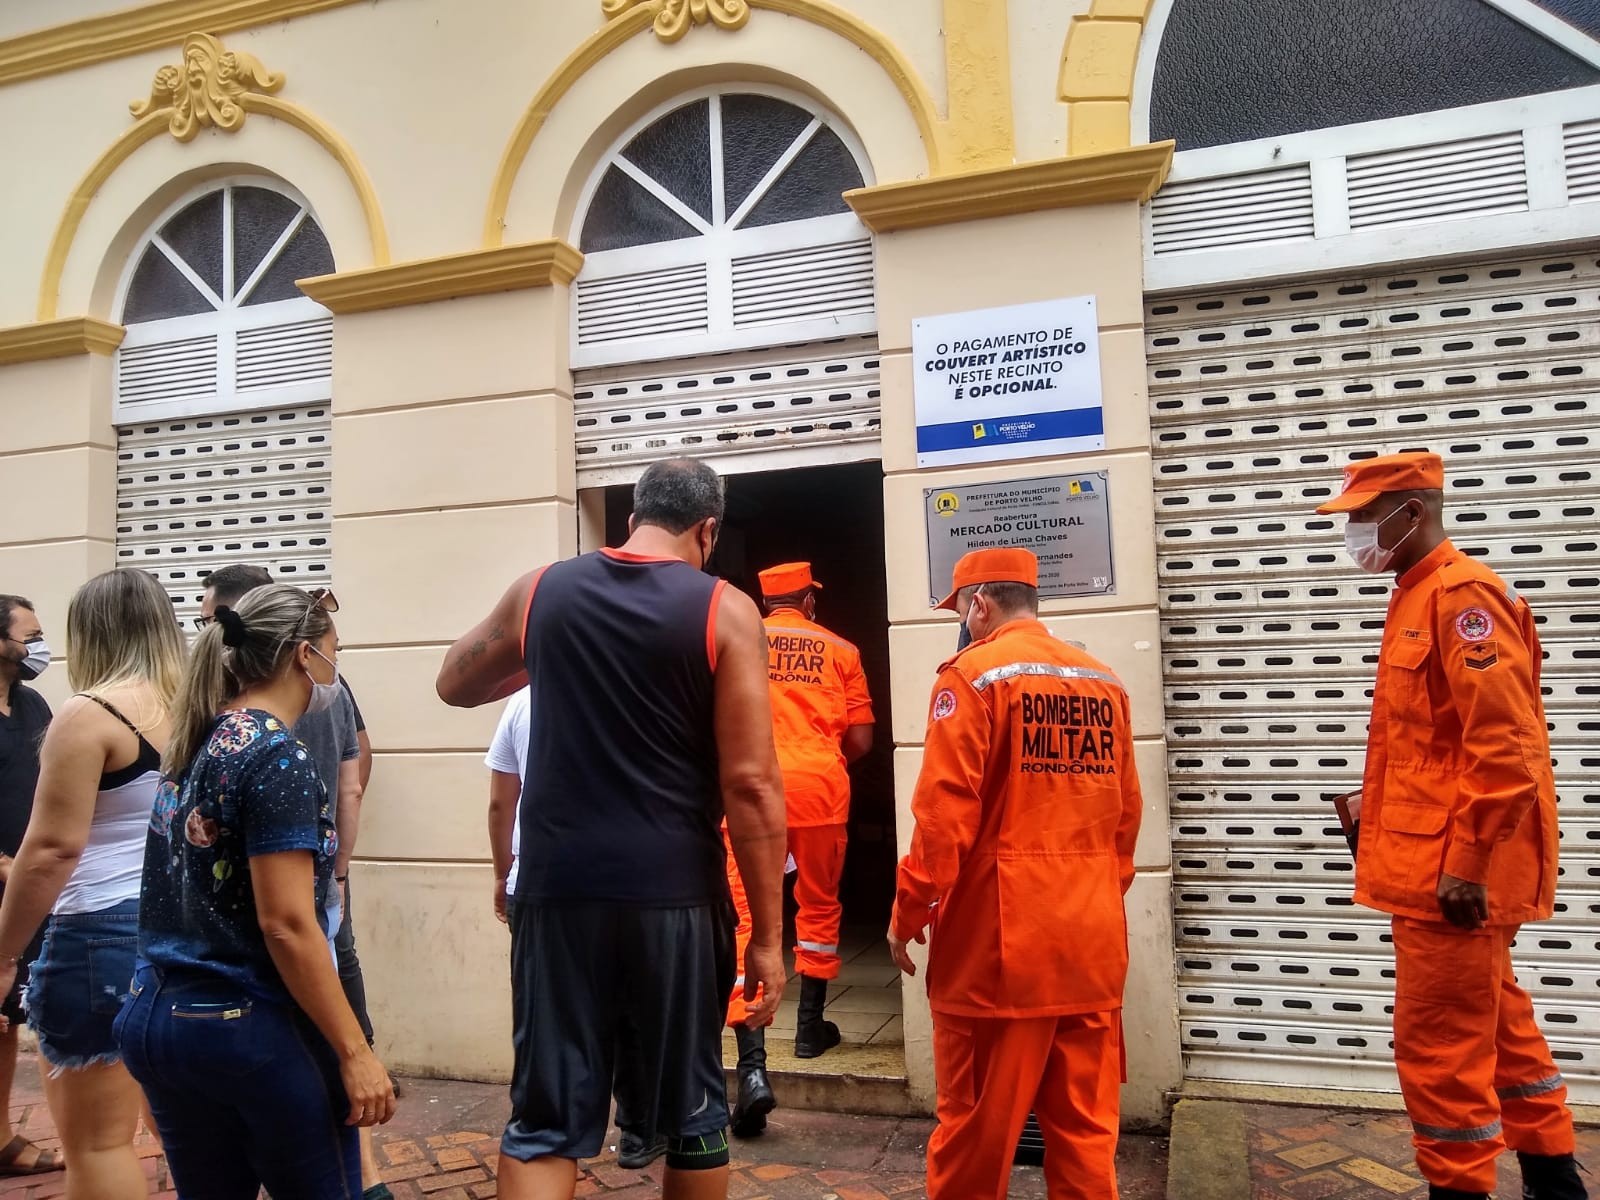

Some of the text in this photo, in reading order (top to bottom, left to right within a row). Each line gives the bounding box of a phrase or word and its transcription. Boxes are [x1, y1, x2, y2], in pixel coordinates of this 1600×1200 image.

[936, 327, 1073, 355] O PAGAMENTO DE
[925, 341, 1087, 372] COUVERT ARTÍSTICO
[948, 360, 1063, 385] NESTE RECINTO
[954, 377, 1057, 400] É OPCIONAL.
[966, 493, 1008, 501] PREFEITURA
[1021, 486, 1061, 496] MUNICÍPIO
[1020, 495, 1043, 503] VELHO
[950, 516, 1085, 537] MERCADO CULTURAL
[994, 513, 1037, 522] Reabertura
[967, 539, 995, 548] Hildon
[997, 538, 1009, 546] de
[1011, 535, 1033, 544] Lima
[1035, 533, 1068, 543] Chaves
[1037, 552, 1073, 561] ernandes
[767, 635, 825, 654] MBEIRO
[1021, 692, 1114, 728] BOMBEIRO
[1021, 727, 1115, 760] MILITAR
[1020, 760, 1116, 775] RONDÔNIA
